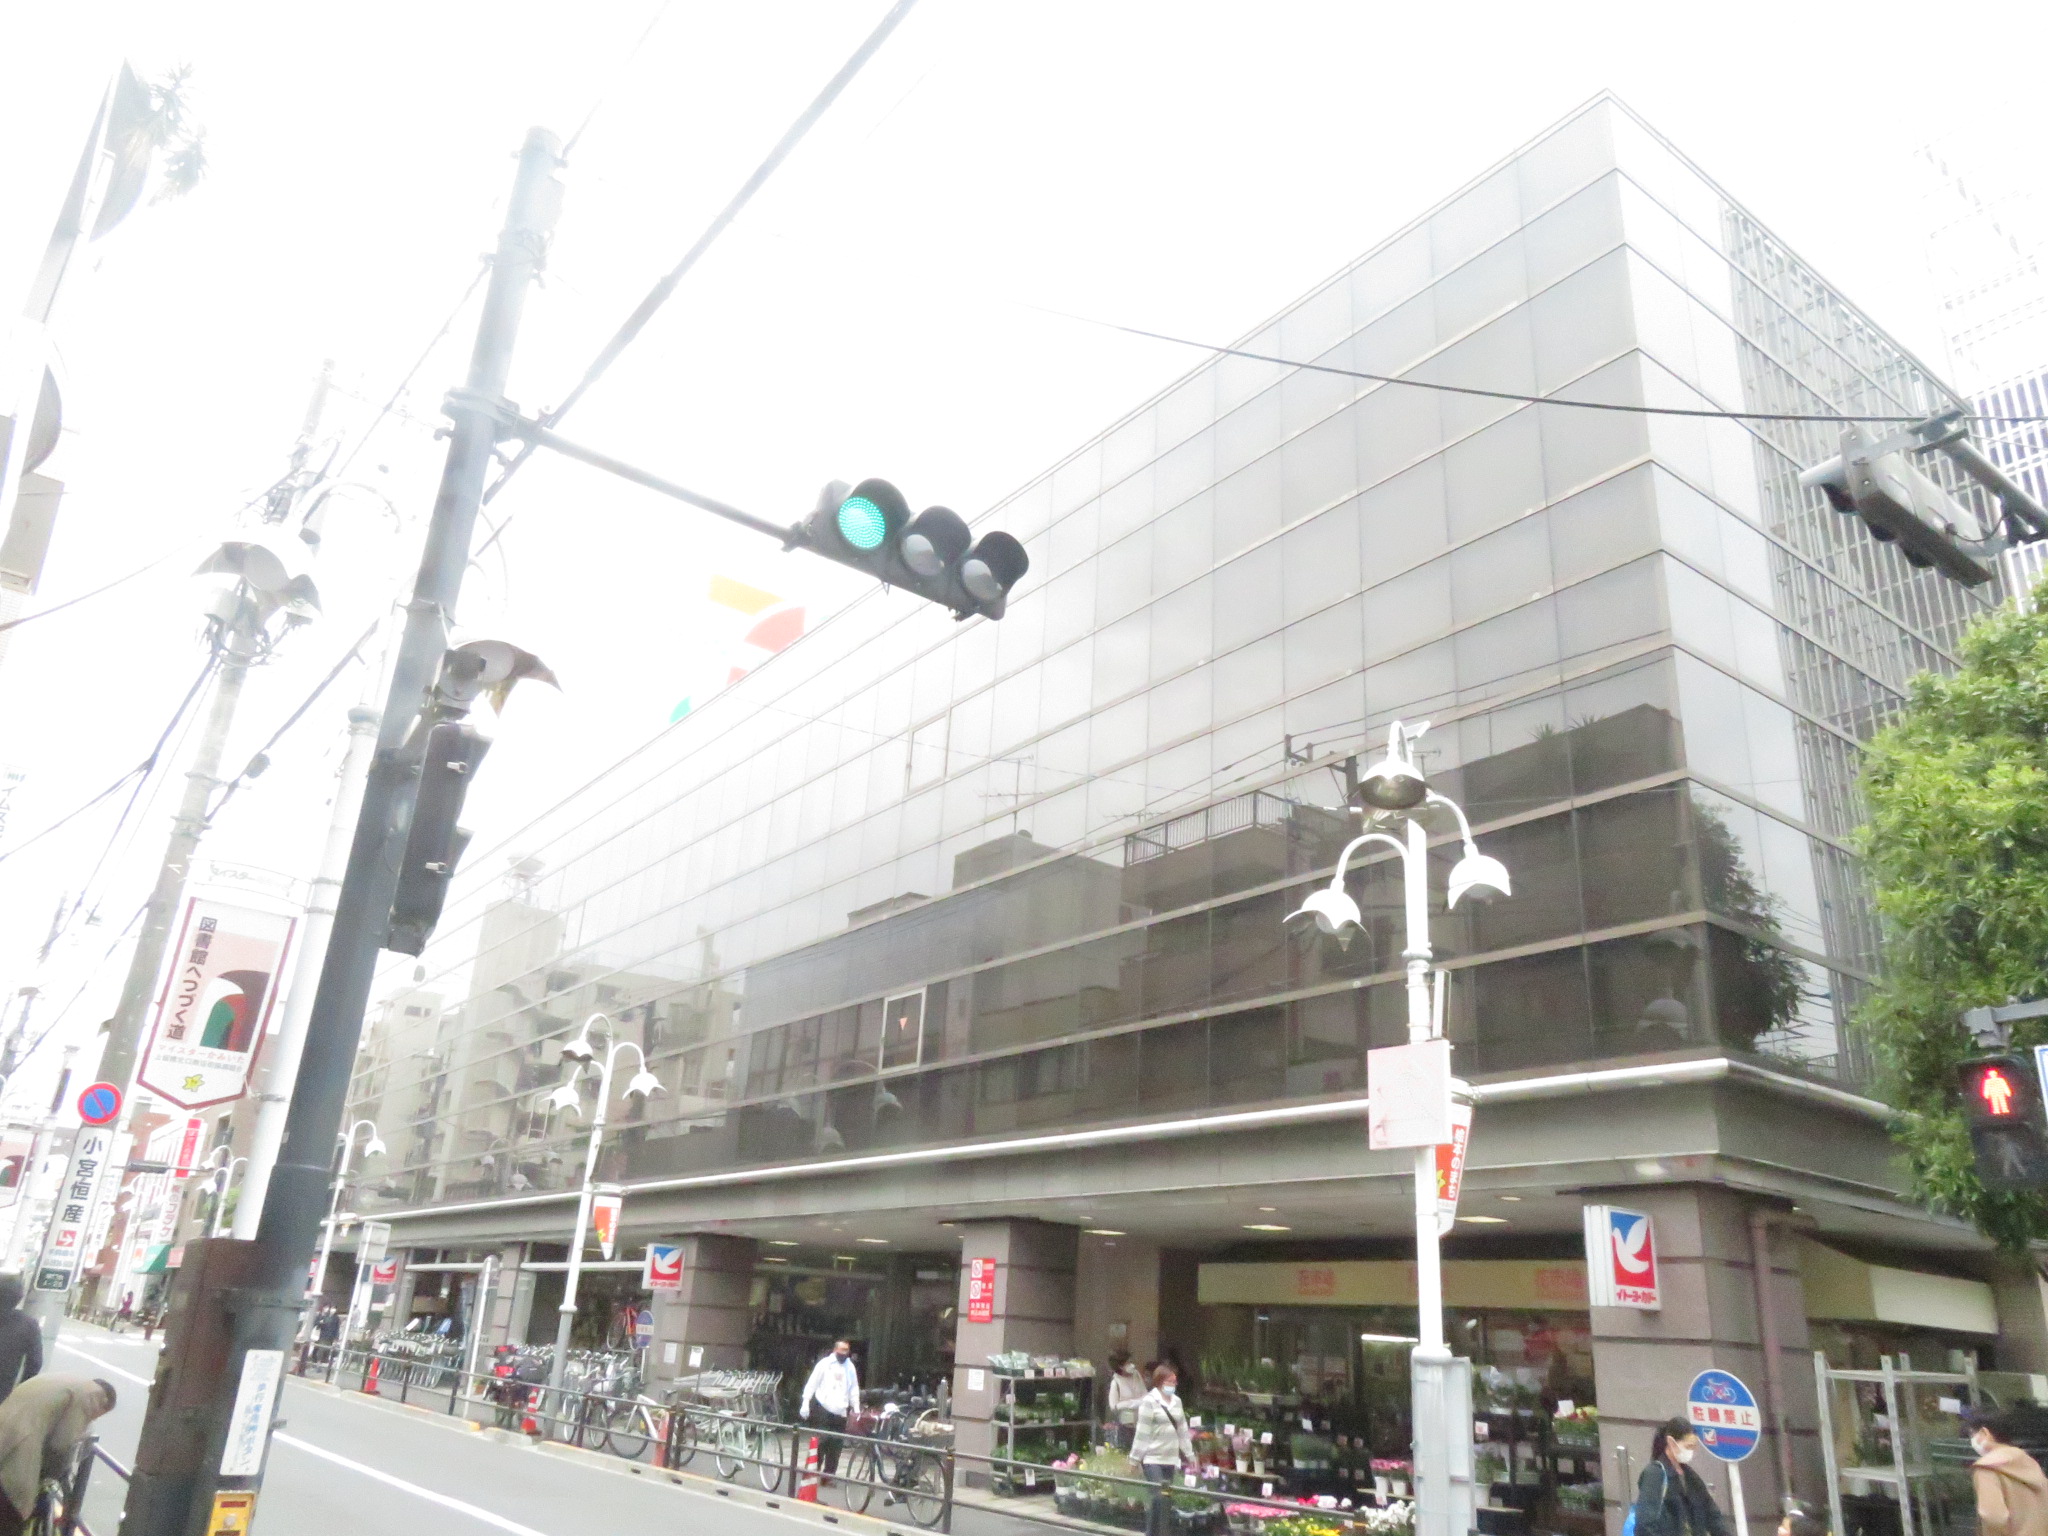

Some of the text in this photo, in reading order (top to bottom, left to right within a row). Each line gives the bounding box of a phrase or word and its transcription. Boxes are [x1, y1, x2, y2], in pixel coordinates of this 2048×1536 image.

[167, 916, 218, 1041] 図書館へつづく道
[61, 1136, 103, 1224] 小宮恒産
